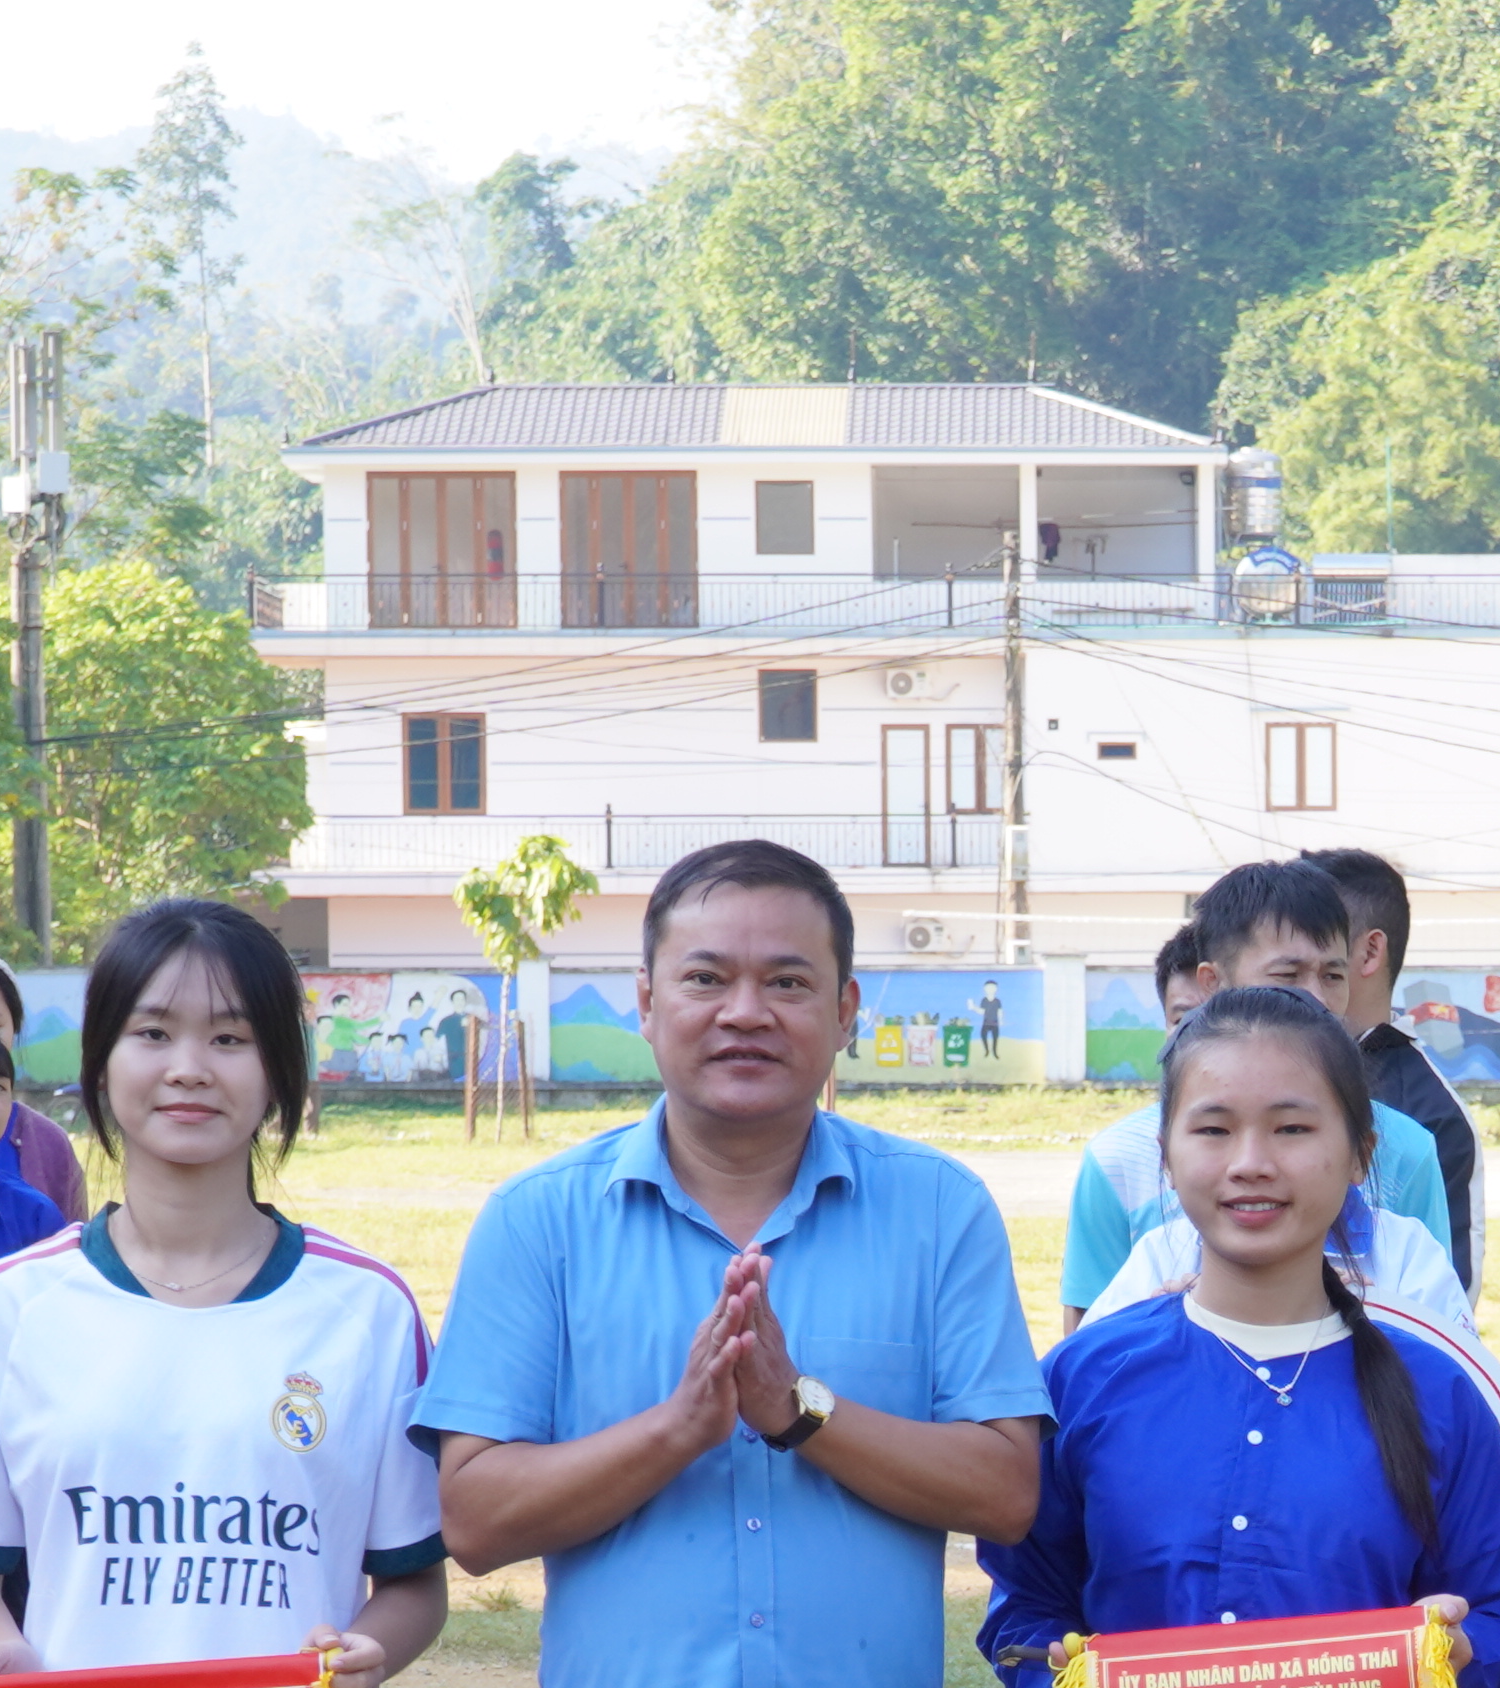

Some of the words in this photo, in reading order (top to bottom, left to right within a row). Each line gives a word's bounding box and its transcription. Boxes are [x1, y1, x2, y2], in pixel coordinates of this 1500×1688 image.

[62, 1481, 320, 1556] Emirates
[100, 1557, 162, 1606] FLY
[171, 1556, 291, 1610] BETTER
[1185, 1664, 1235, 1688] NHÂN
[1238, 1660, 1276, 1683] DÂN
[1279, 1657, 1304, 1679] XÃ
[1306, 1651, 1356, 1676] HỒNG
[1358, 1646, 1398, 1671] THÁI
